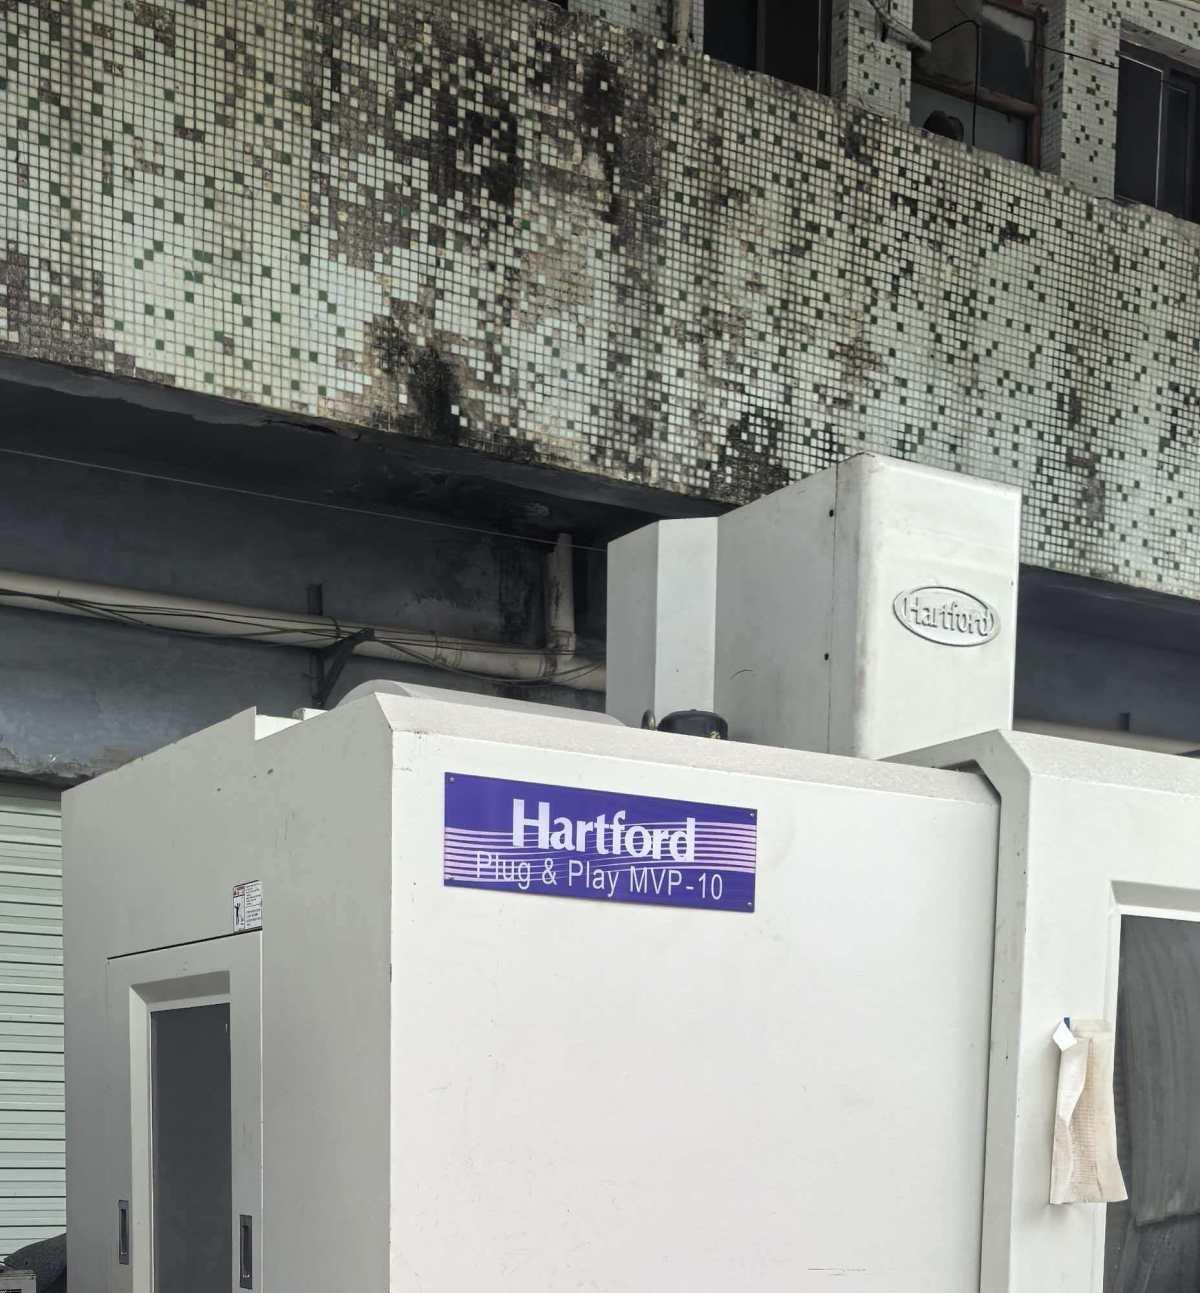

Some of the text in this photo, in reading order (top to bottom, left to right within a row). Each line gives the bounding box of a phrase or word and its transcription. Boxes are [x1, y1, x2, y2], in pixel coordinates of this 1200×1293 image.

[903, 596, 990, 637] Hartford
[512, 798, 696, 862] Hartford
[474, 851, 723, 900] Plug & Play MVP-10
